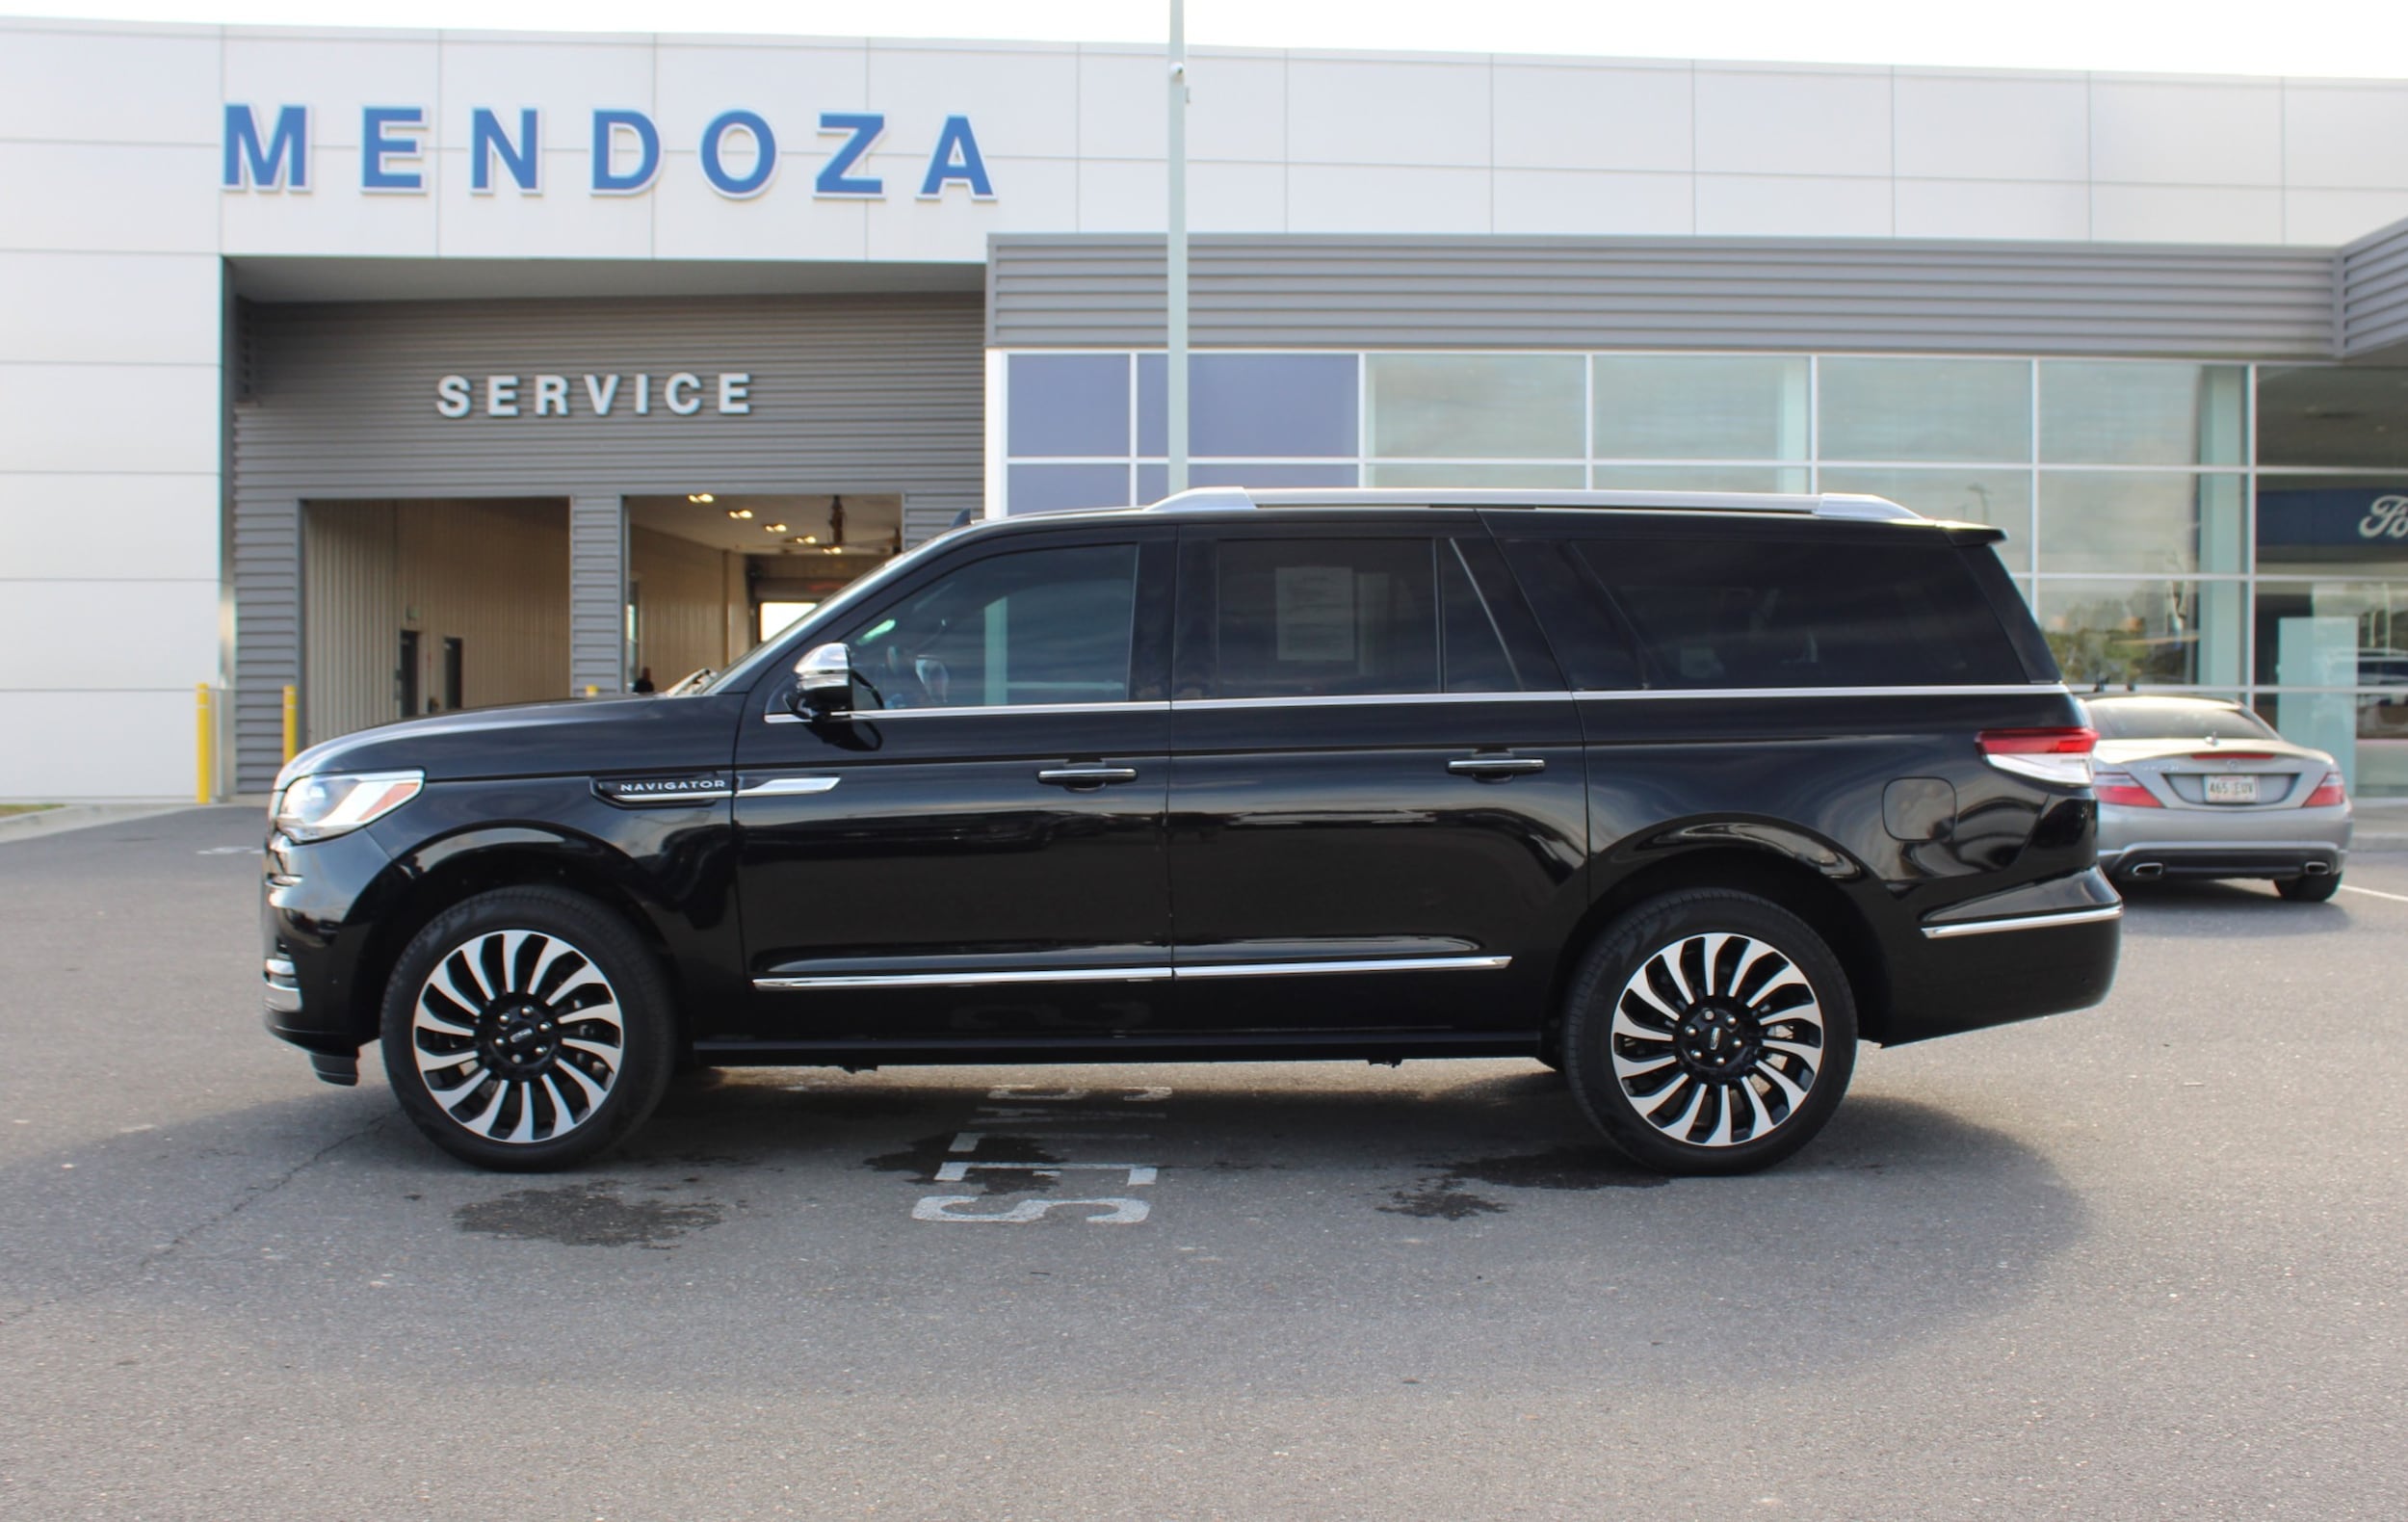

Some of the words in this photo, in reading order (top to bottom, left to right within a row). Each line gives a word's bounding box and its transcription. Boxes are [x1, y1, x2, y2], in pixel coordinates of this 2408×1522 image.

[224, 104, 997, 202] MENDOZA
[436, 373, 751, 418] SERVICE
[620, 781, 725, 792] NAVIGATOR
